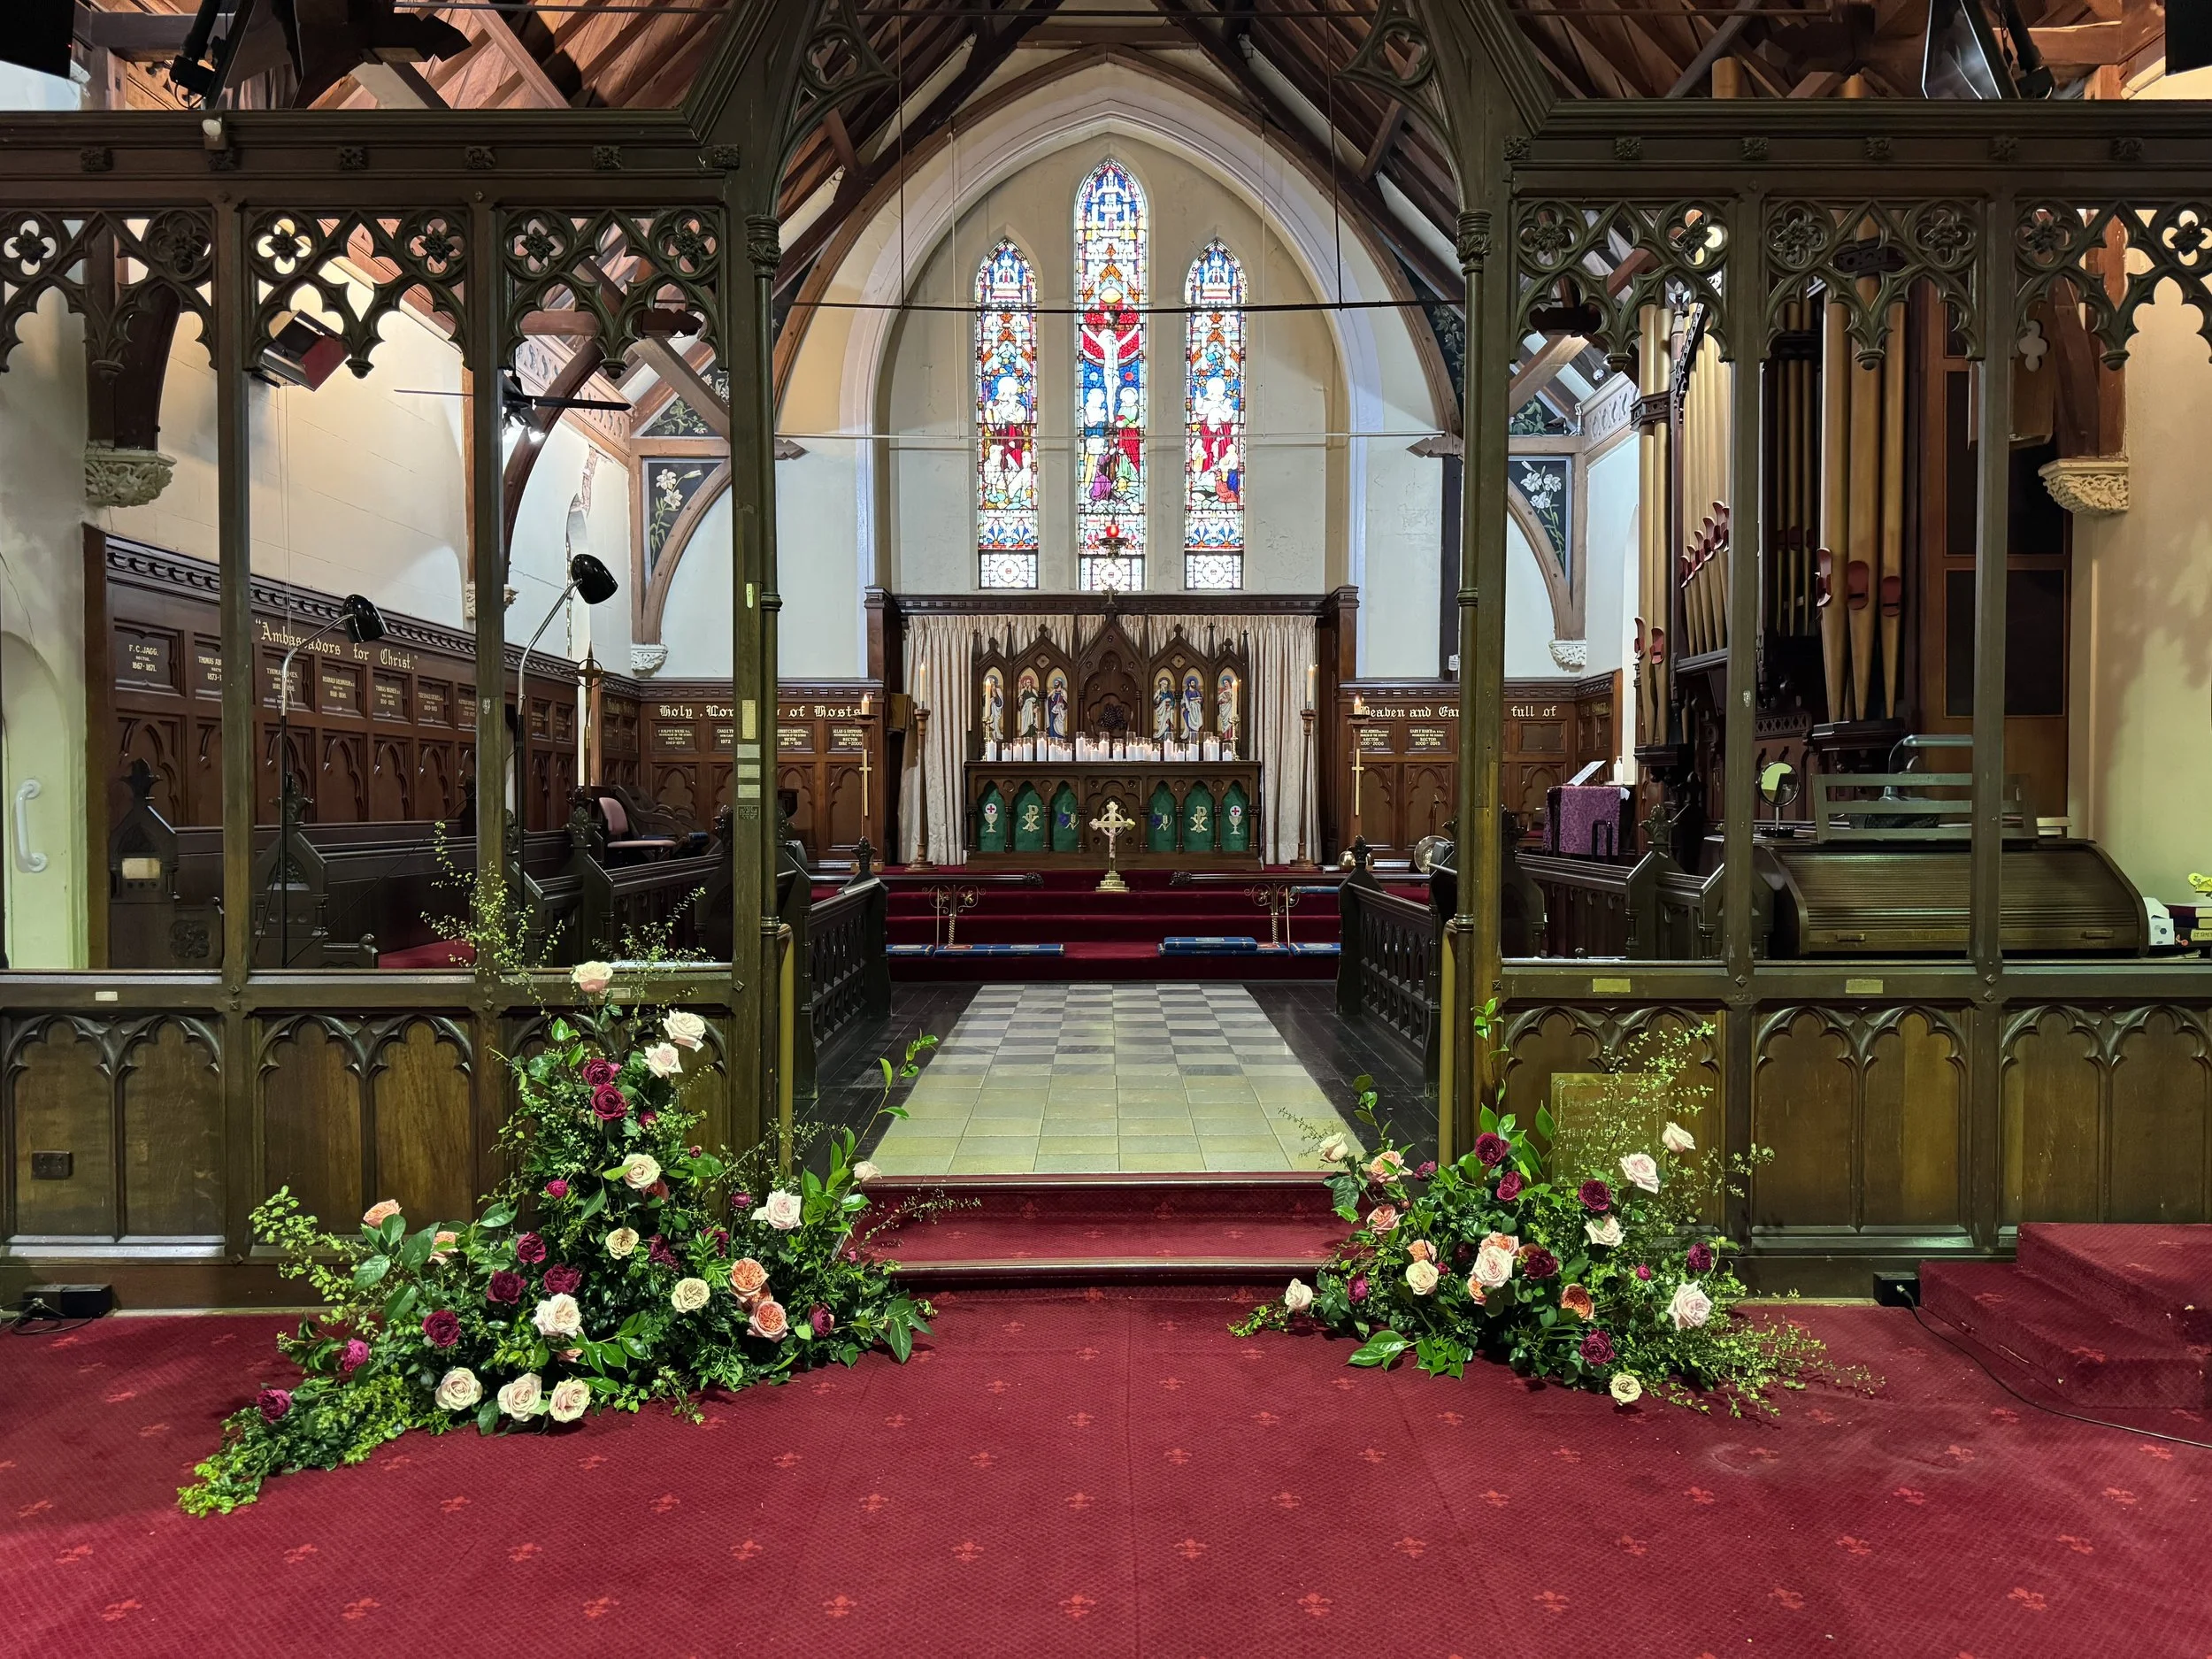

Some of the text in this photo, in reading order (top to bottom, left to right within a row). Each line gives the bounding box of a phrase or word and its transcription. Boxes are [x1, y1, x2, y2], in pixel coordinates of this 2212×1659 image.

[353, 643, 370, 661] for
[705, 704, 733, 718] Lor
[788, 705, 806, 718] of
[1409, 705, 1432, 718] and
[1510, 705, 1535, 717] full
[1542, 705, 1557, 717] of
